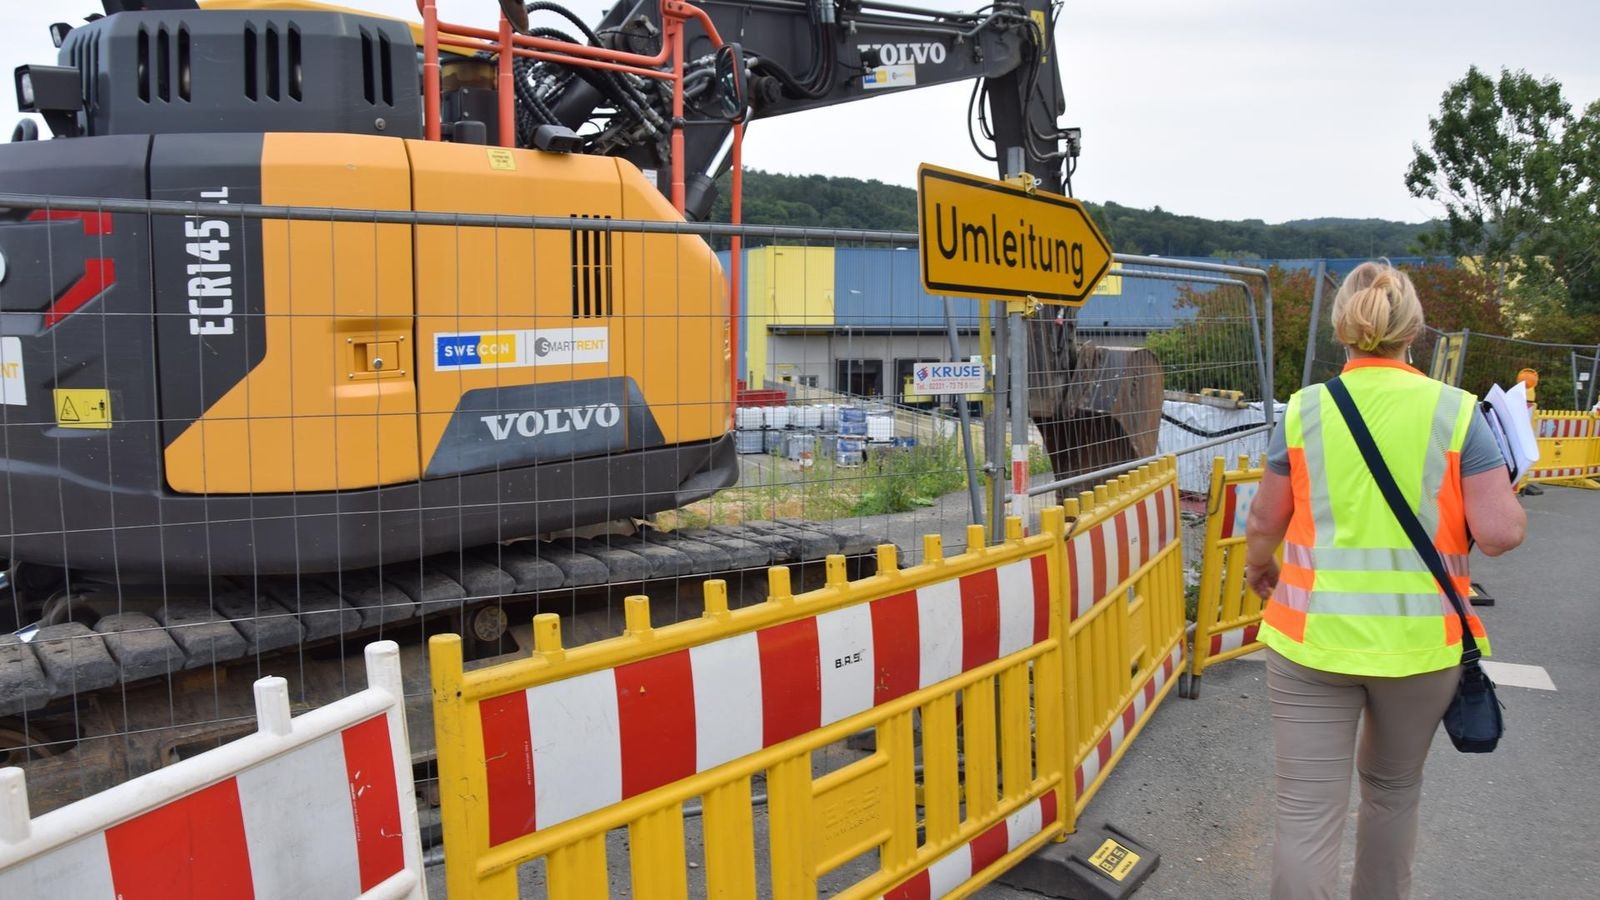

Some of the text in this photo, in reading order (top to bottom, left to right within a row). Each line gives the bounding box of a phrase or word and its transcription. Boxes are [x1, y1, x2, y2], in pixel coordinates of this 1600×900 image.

[857, 42, 946, 65] OLVO
[184, 186, 234, 335] ECR145L
[936, 203, 1083, 289] Umleitung
[444, 343, 509, 357] SWECON
[932, 366, 981, 377] KRUSE
[480, 402, 620, 441] VOLVO
